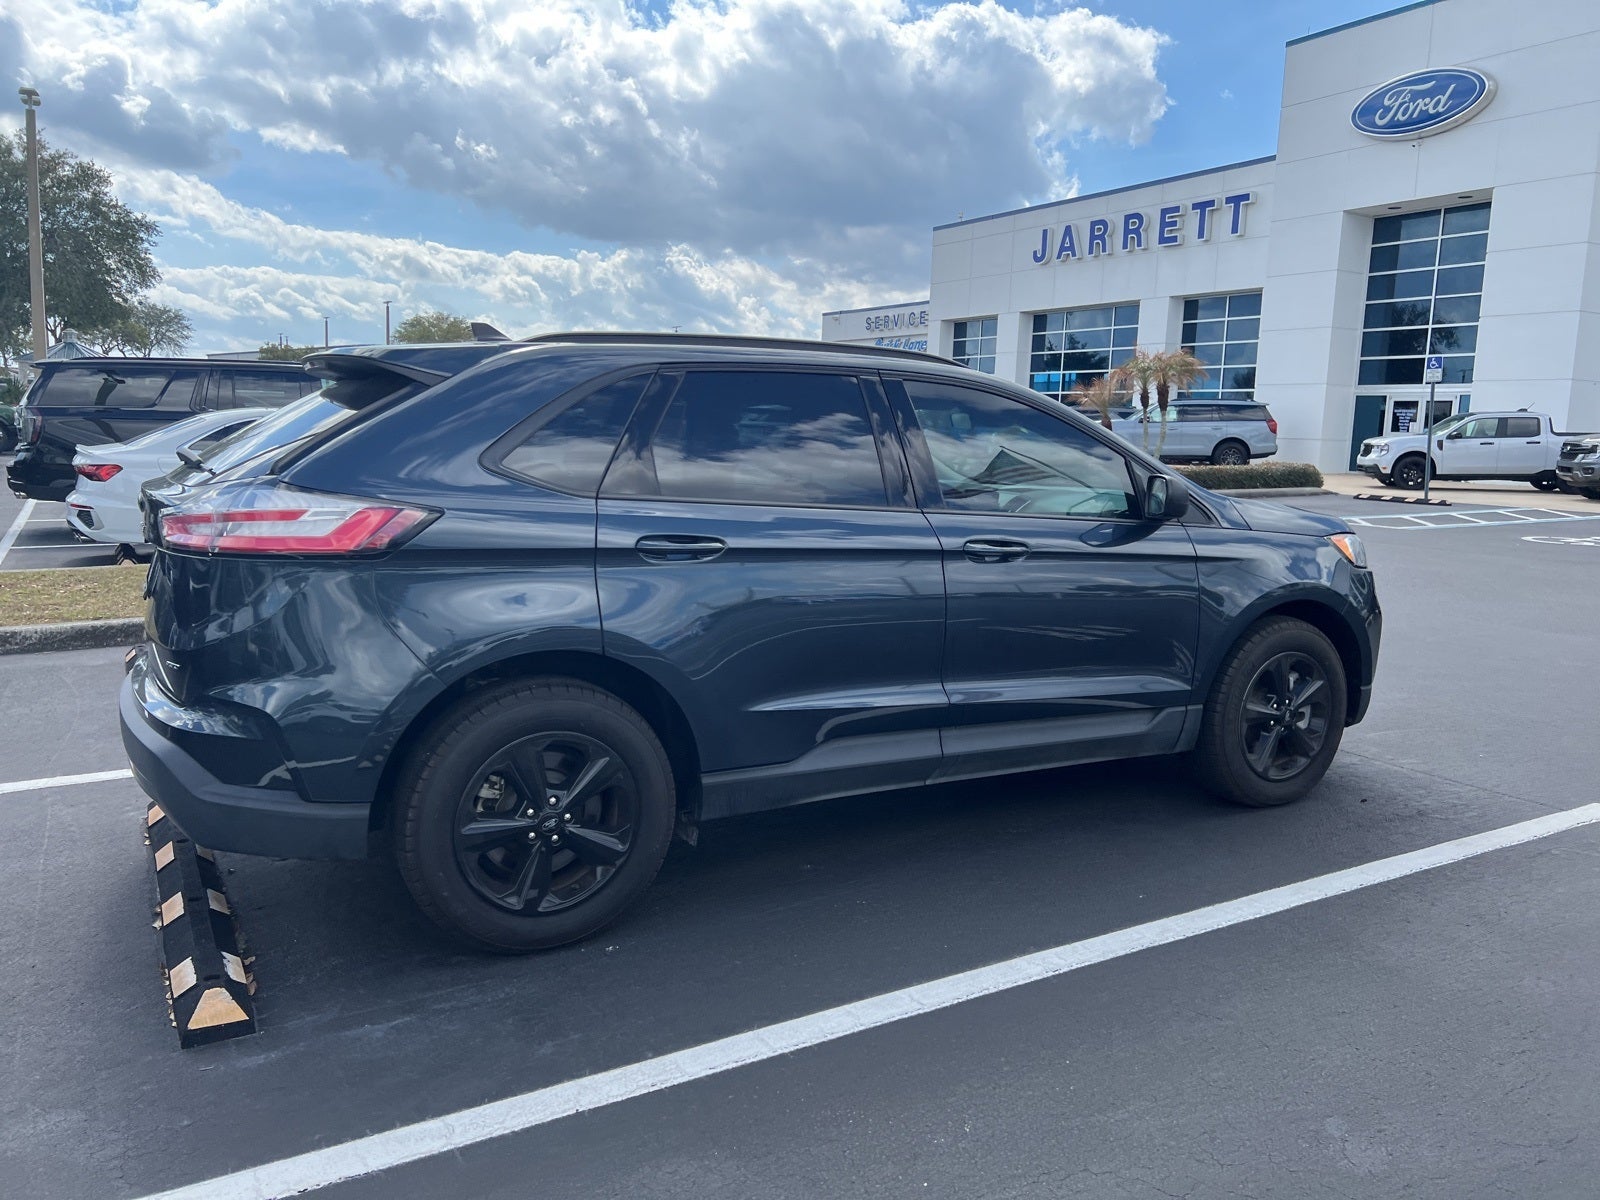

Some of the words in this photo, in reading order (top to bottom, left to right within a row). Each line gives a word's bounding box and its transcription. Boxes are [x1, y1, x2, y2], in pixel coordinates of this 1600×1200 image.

[1374, 80, 1456, 126] Ford
[1032, 193, 1252, 264] JARRETT
[865, 310, 927, 331] SERVICE
